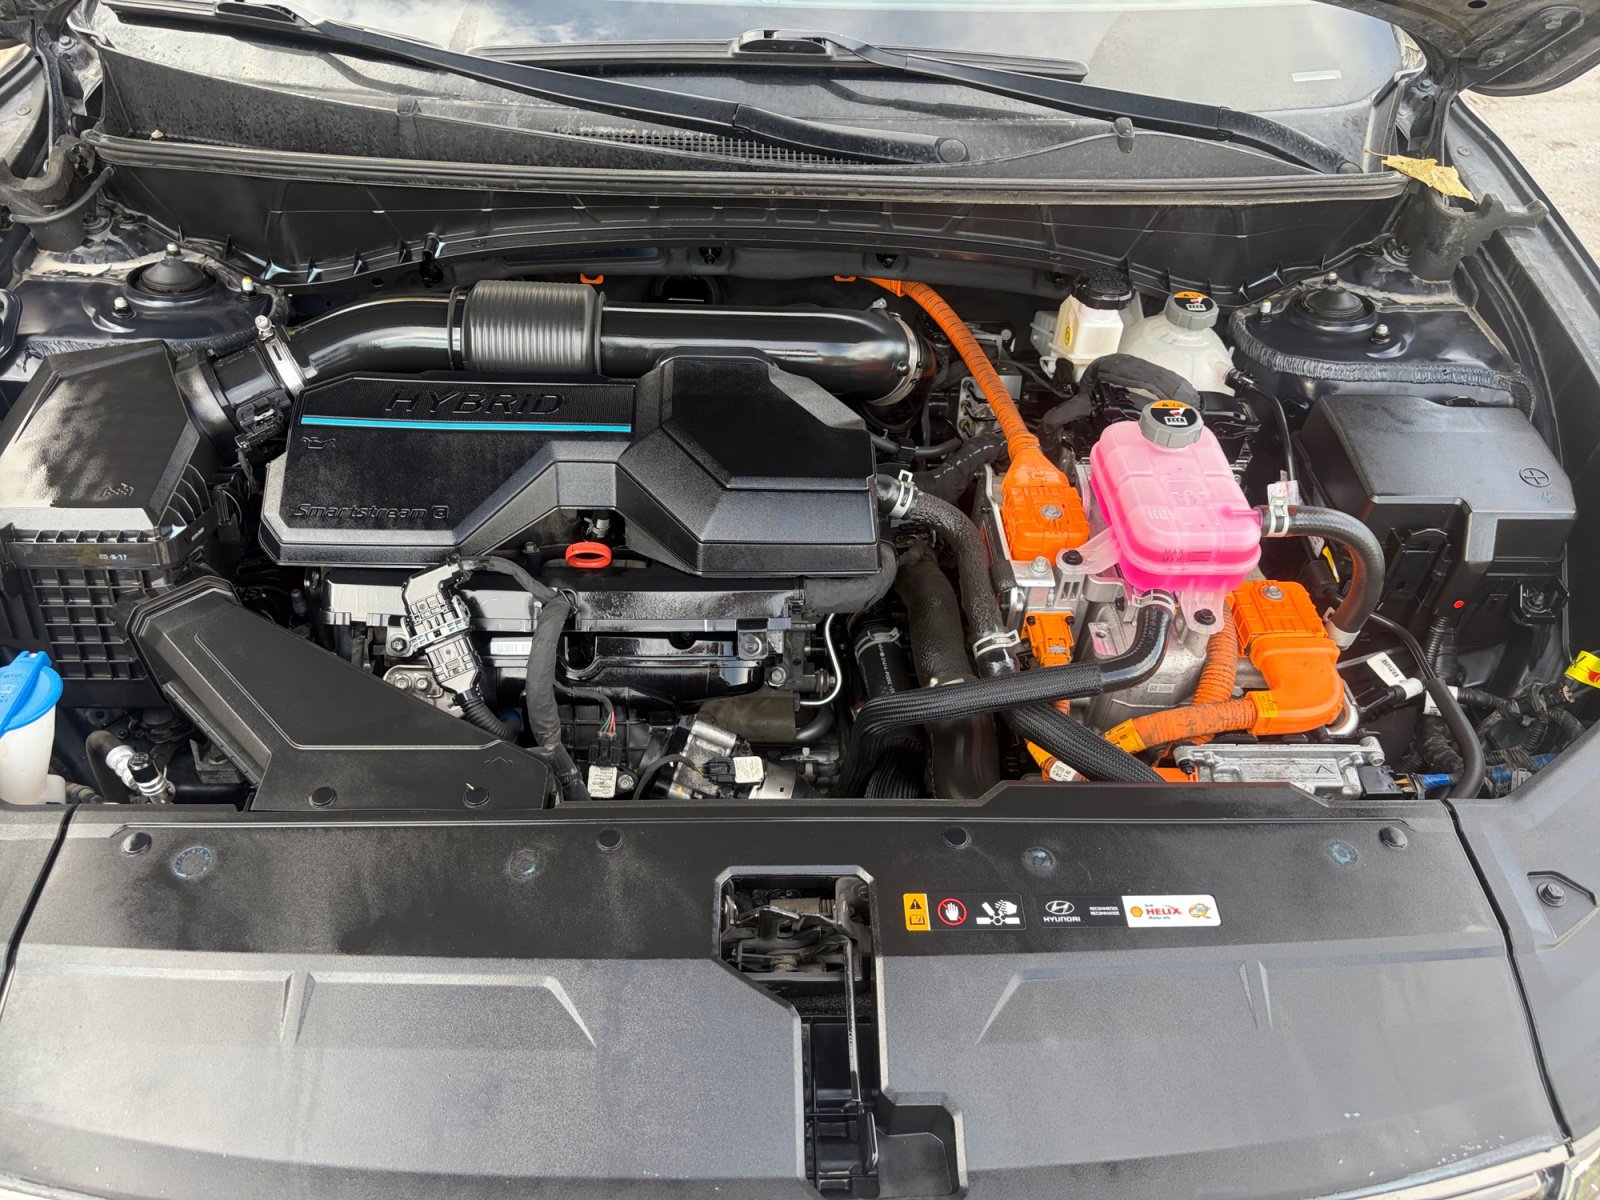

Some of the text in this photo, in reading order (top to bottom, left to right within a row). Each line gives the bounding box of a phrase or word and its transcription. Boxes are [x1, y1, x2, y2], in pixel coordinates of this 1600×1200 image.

[385, 391, 565, 415] HYBRID
[294, 503, 428, 519] Smartstream
[1145, 907, 1183, 916] HELIX
